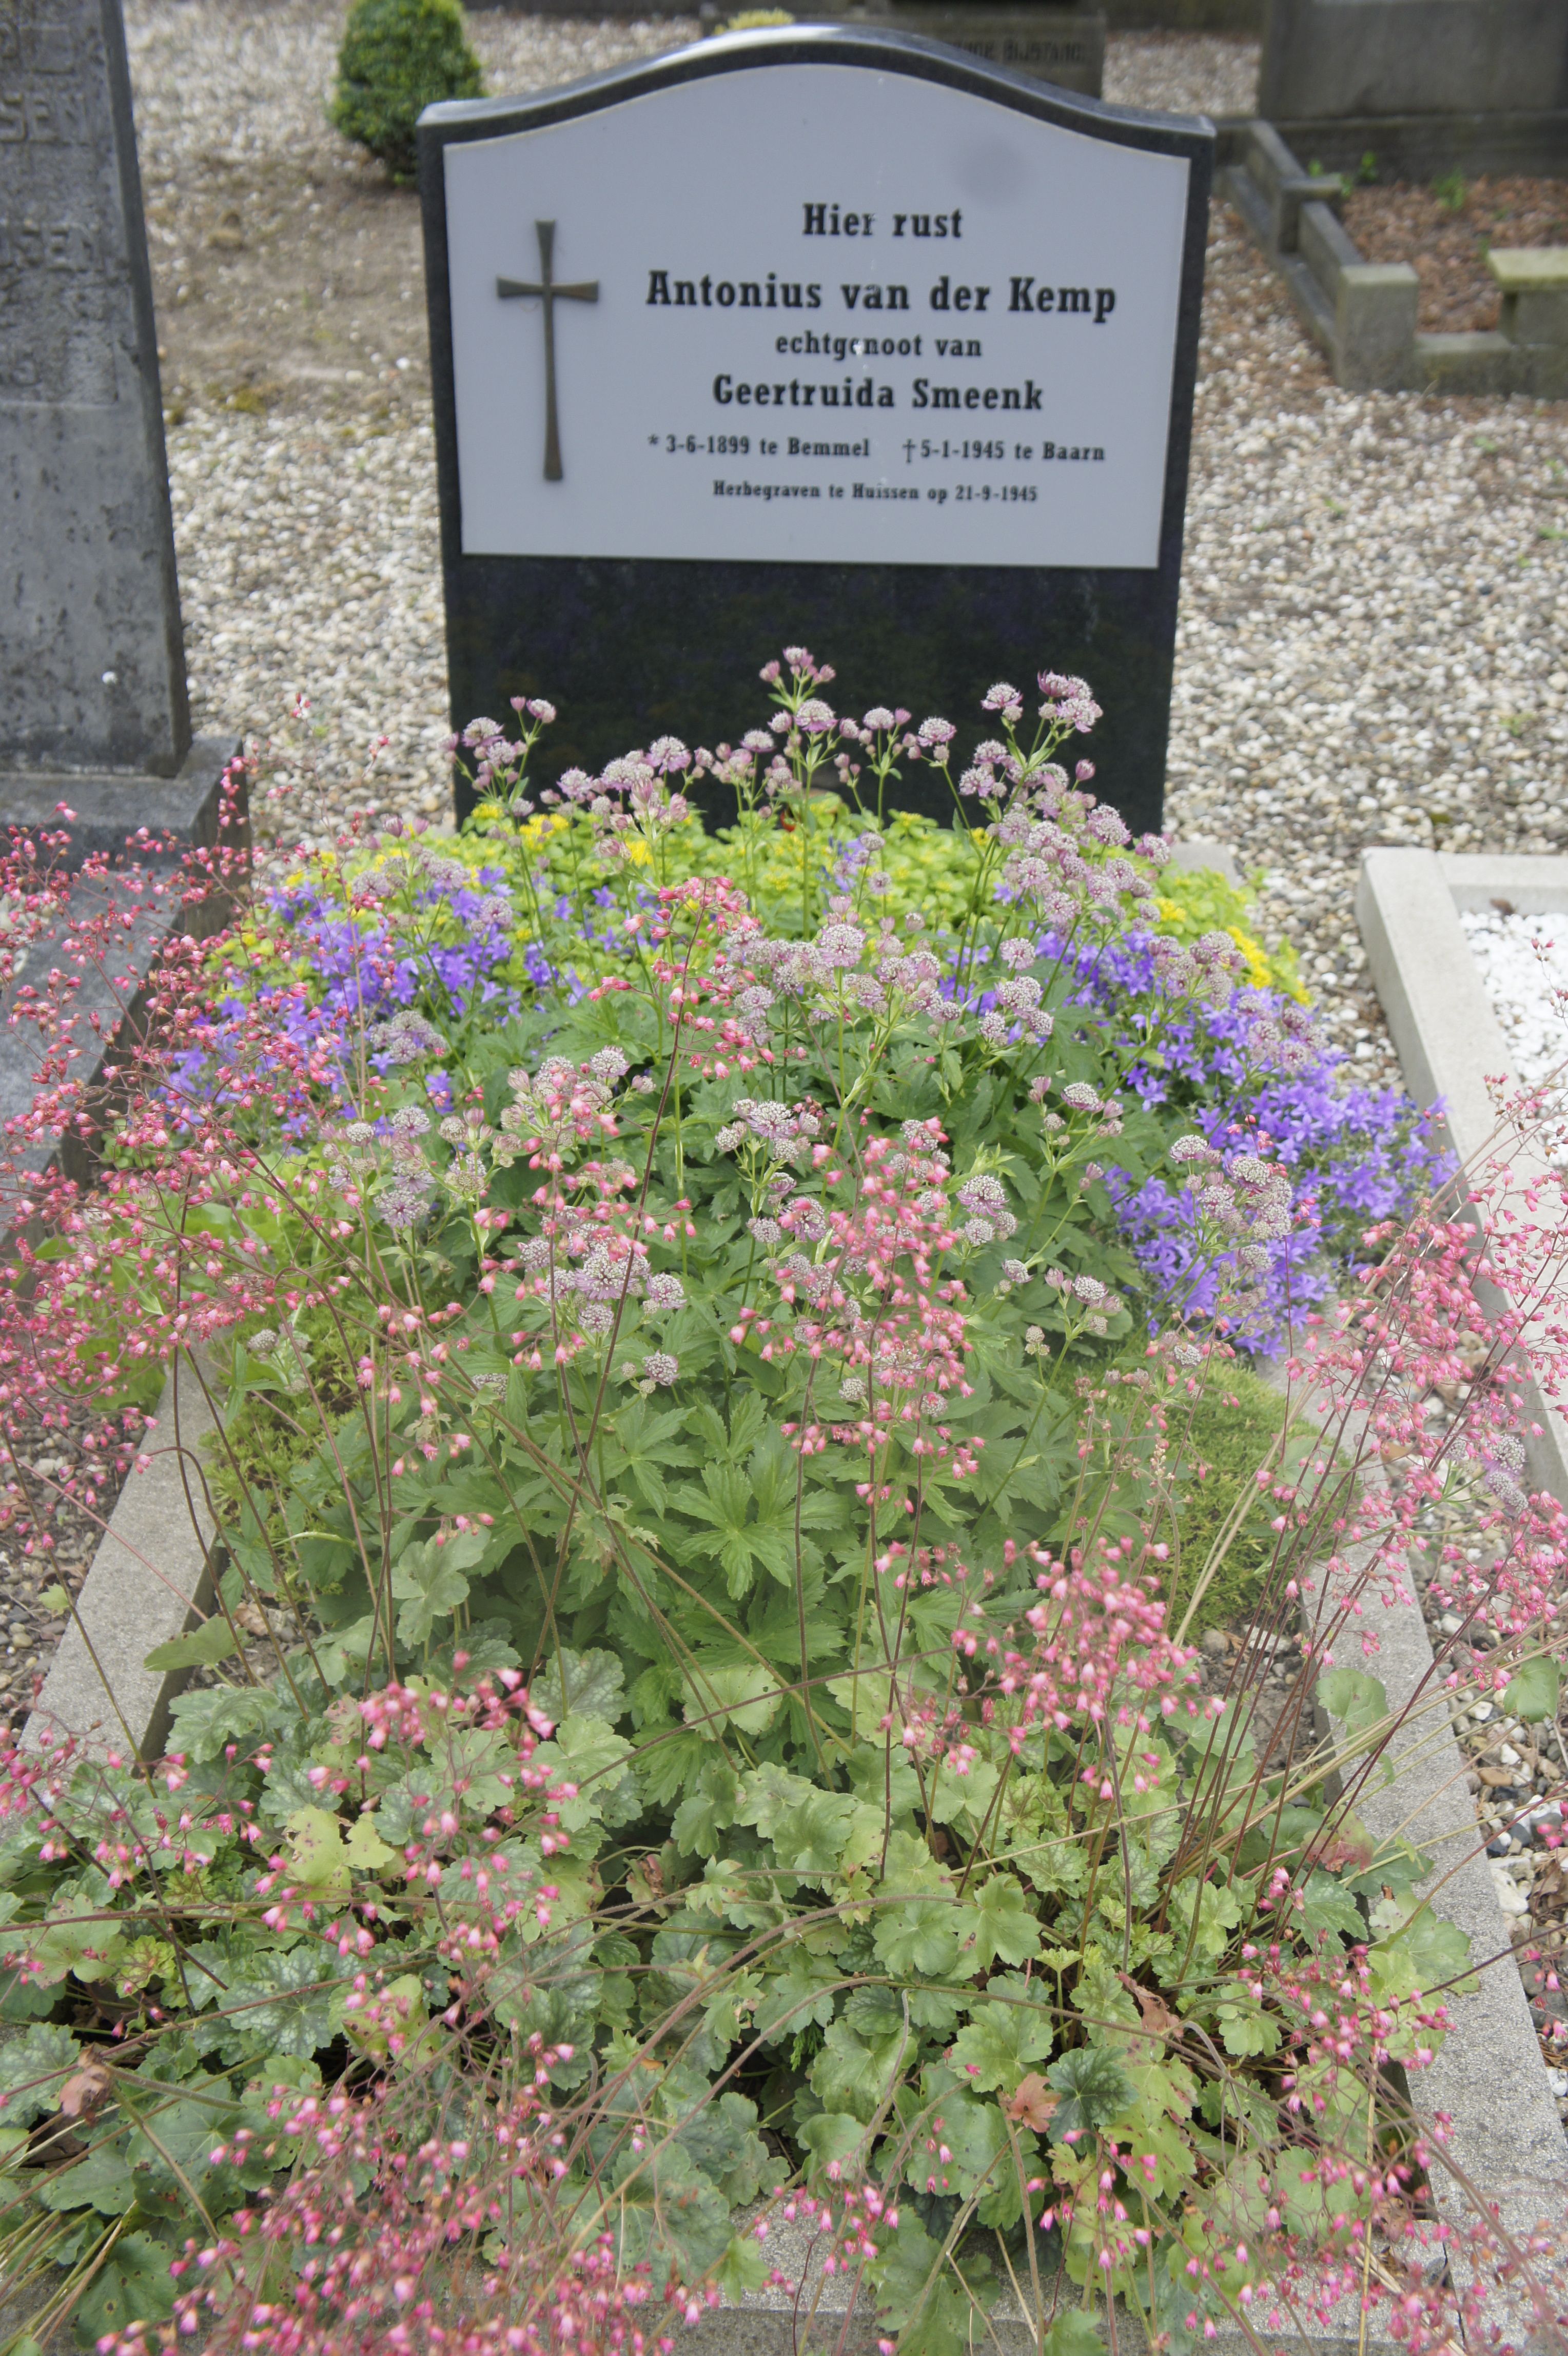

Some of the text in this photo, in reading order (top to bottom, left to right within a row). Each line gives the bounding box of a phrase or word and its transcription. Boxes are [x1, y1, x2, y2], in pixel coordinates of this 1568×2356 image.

[803, 203, 962, 239] Hier rust
[646, 270, 1116, 324] Antonius van der Kemp
[776, 330, 982, 362] echtgenoot van
[713, 374, 1042, 410] Geertruida Smeenk
[760, 439, 778, 455] te
[788, 437, 869, 457] Bemmel
[1014, 443, 1033, 460] te
[1043, 442, 1105, 461] Baarn
[713, 480, 1037, 505] Herbegraven te Huissen op 21-9-1945
